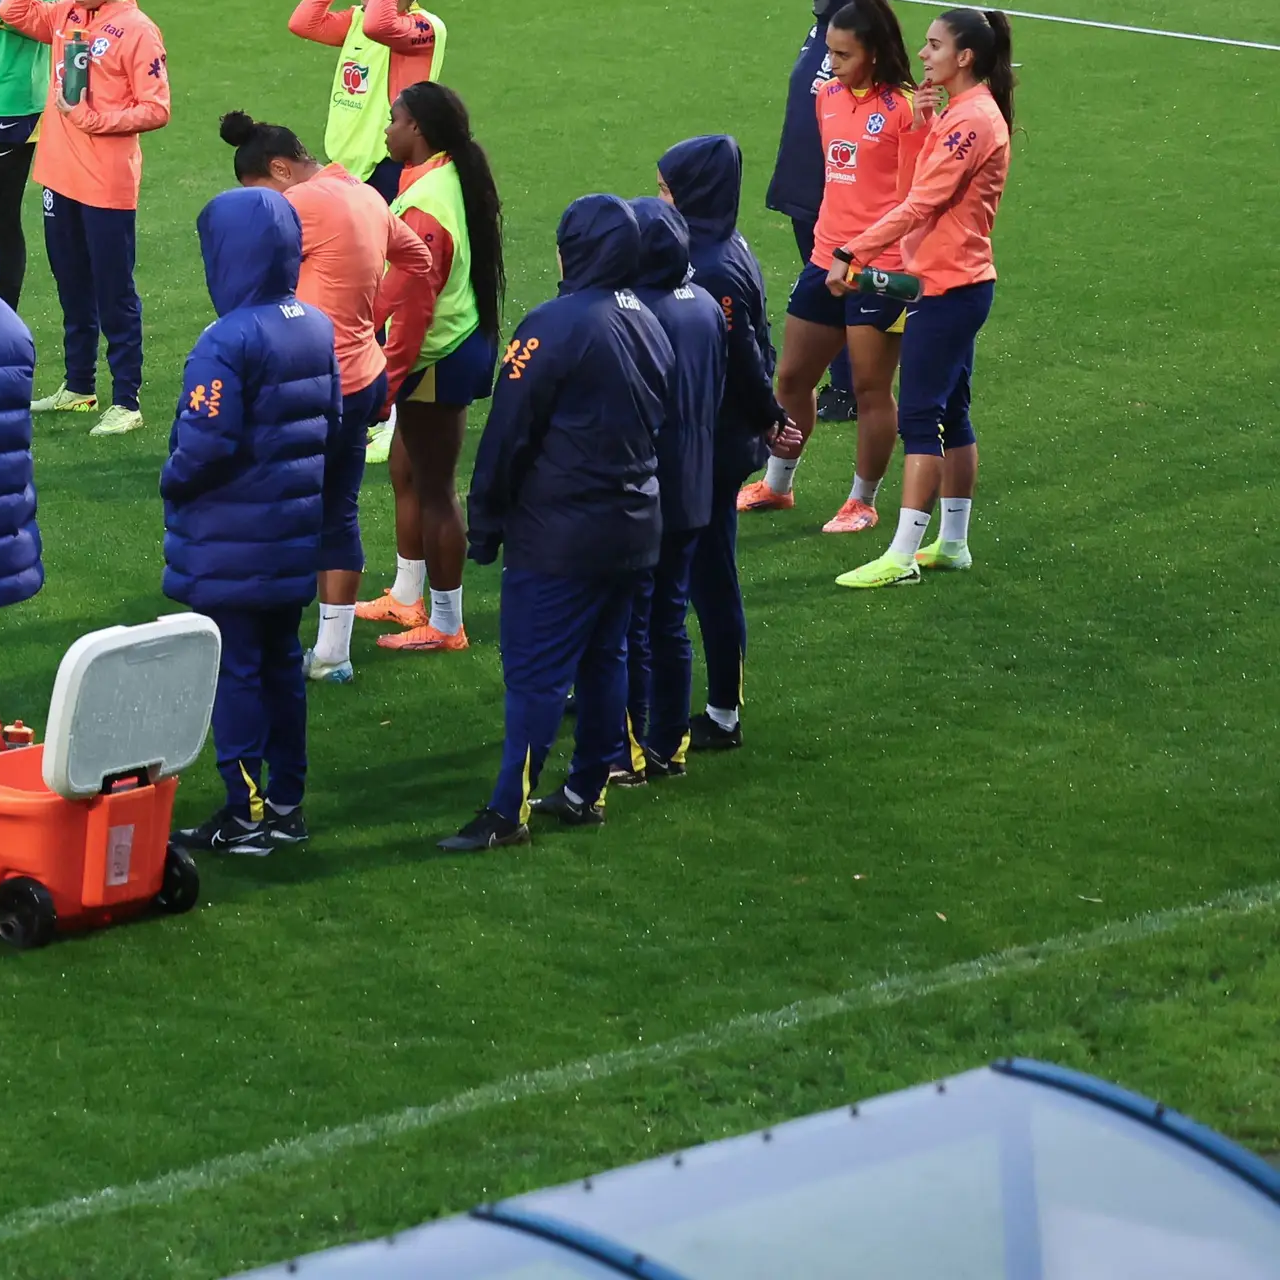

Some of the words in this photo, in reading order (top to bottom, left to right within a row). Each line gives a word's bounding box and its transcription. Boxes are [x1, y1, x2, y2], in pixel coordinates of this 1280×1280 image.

[956, 131, 977, 160] vivo
[509, 338, 539, 379] vivo
[205, 379, 223, 418] vivo
